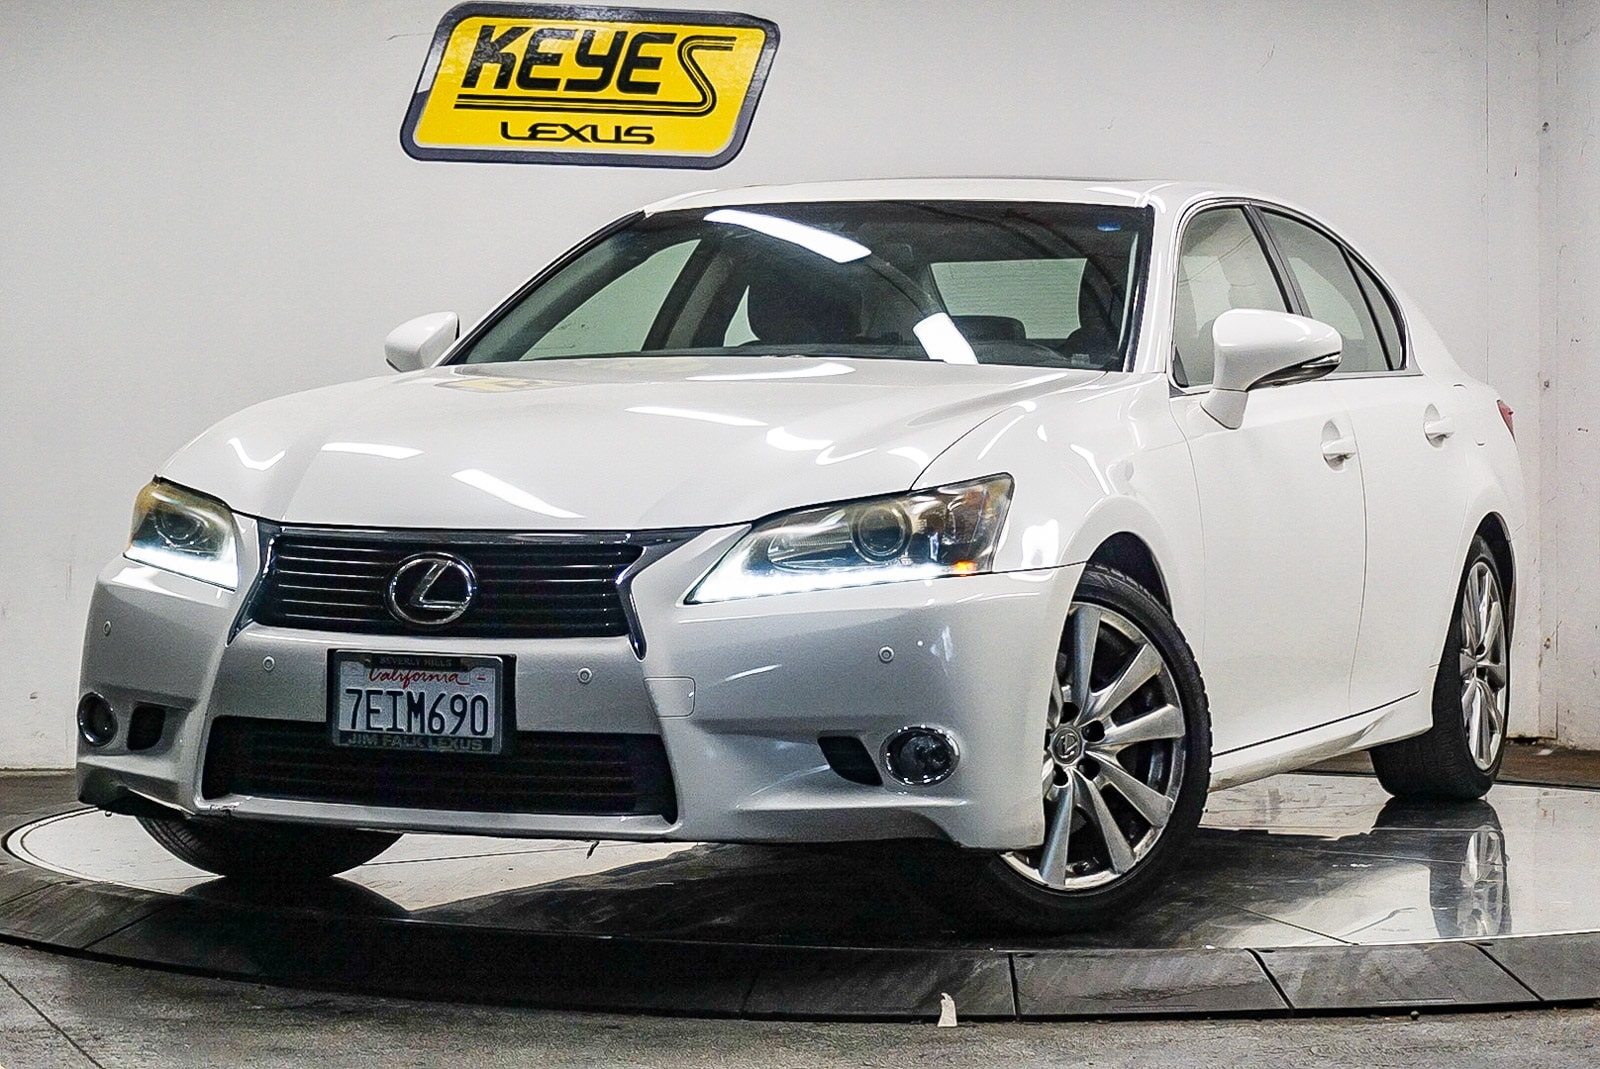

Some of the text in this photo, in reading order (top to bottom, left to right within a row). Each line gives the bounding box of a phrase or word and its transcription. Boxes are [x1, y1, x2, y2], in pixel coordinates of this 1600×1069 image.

[455, 25, 736, 117] KEYES
[501, 121, 655, 145] LEXUS
[369, 668, 470, 689] California
[346, 688, 489, 736] 7EIM690
[348, 732, 378, 745] JIM
[429, 737, 483, 750] LEXUS
